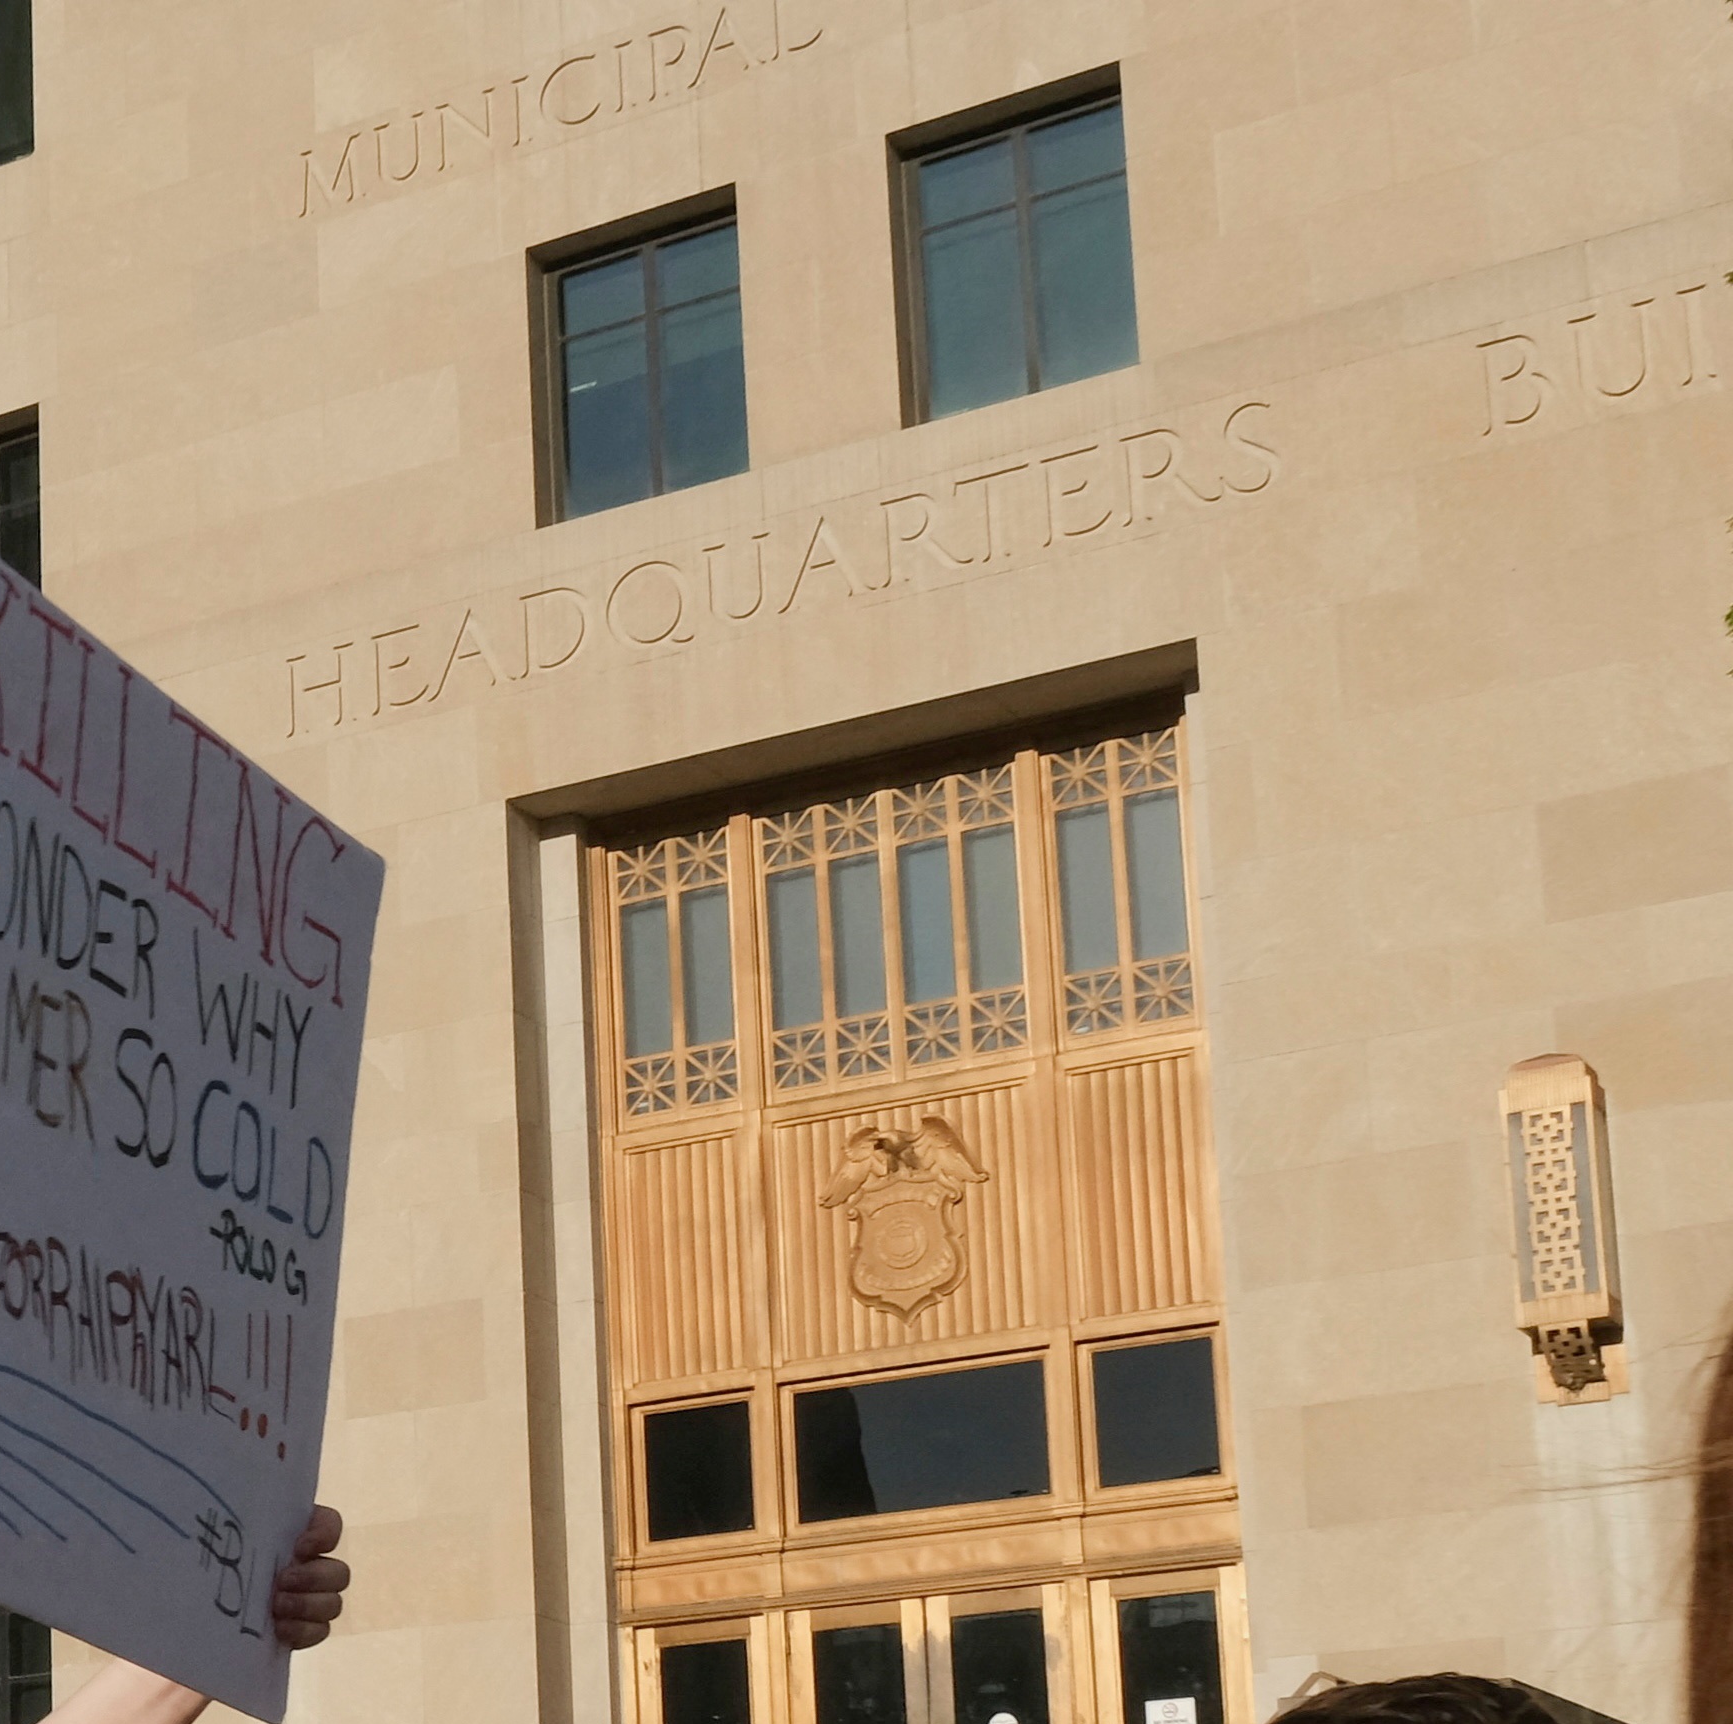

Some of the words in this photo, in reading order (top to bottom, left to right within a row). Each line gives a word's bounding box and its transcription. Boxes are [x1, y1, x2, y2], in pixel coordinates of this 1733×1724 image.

[298, 0, 824, 219] MUNICIPAL
[283, 400, 1281, 738] HEADQUARTERS
[195, 928, 313, 1108] WHY
[113, 1028, 178, 1168] SO
[193, 1080, 333, 1242] COLD
[284, 1248, 309, 1306] G
